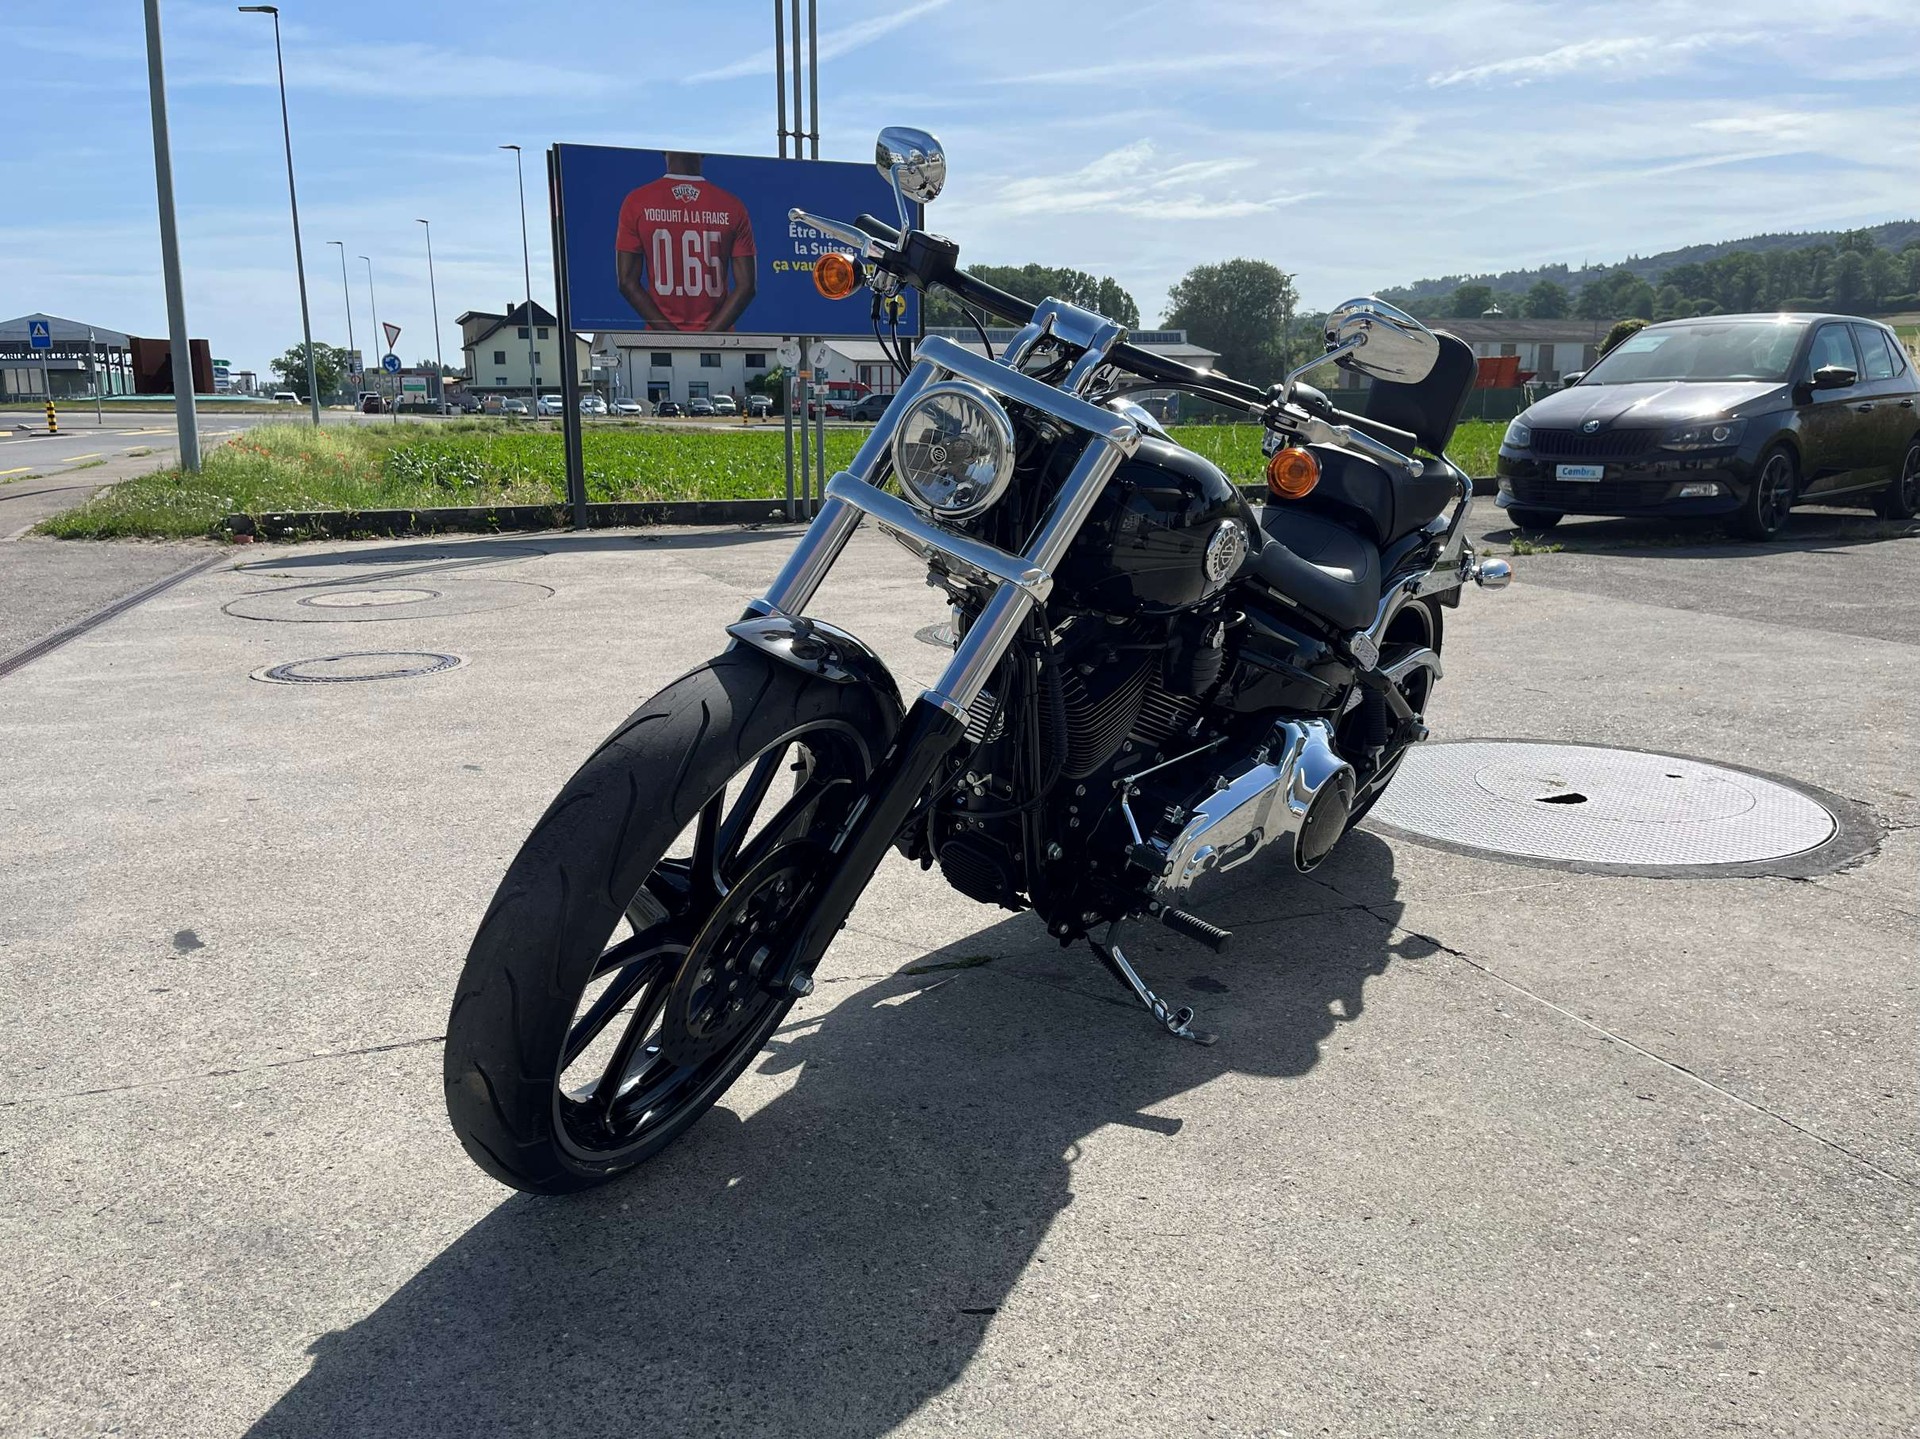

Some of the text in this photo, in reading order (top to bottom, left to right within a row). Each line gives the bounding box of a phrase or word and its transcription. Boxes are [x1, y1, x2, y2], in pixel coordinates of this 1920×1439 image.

[673, 187, 699, 199] SUISSE
[644, 208, 730, 225] YOGOURT À LA FRAISE
[788, 221, 817, 239] Être
[794, 241, 808, 255] la
[652, 228, 724, 298] 0.65
[772, 260, 815, 274] ça vau
[1562, 467, 1597, 477] Cembra
